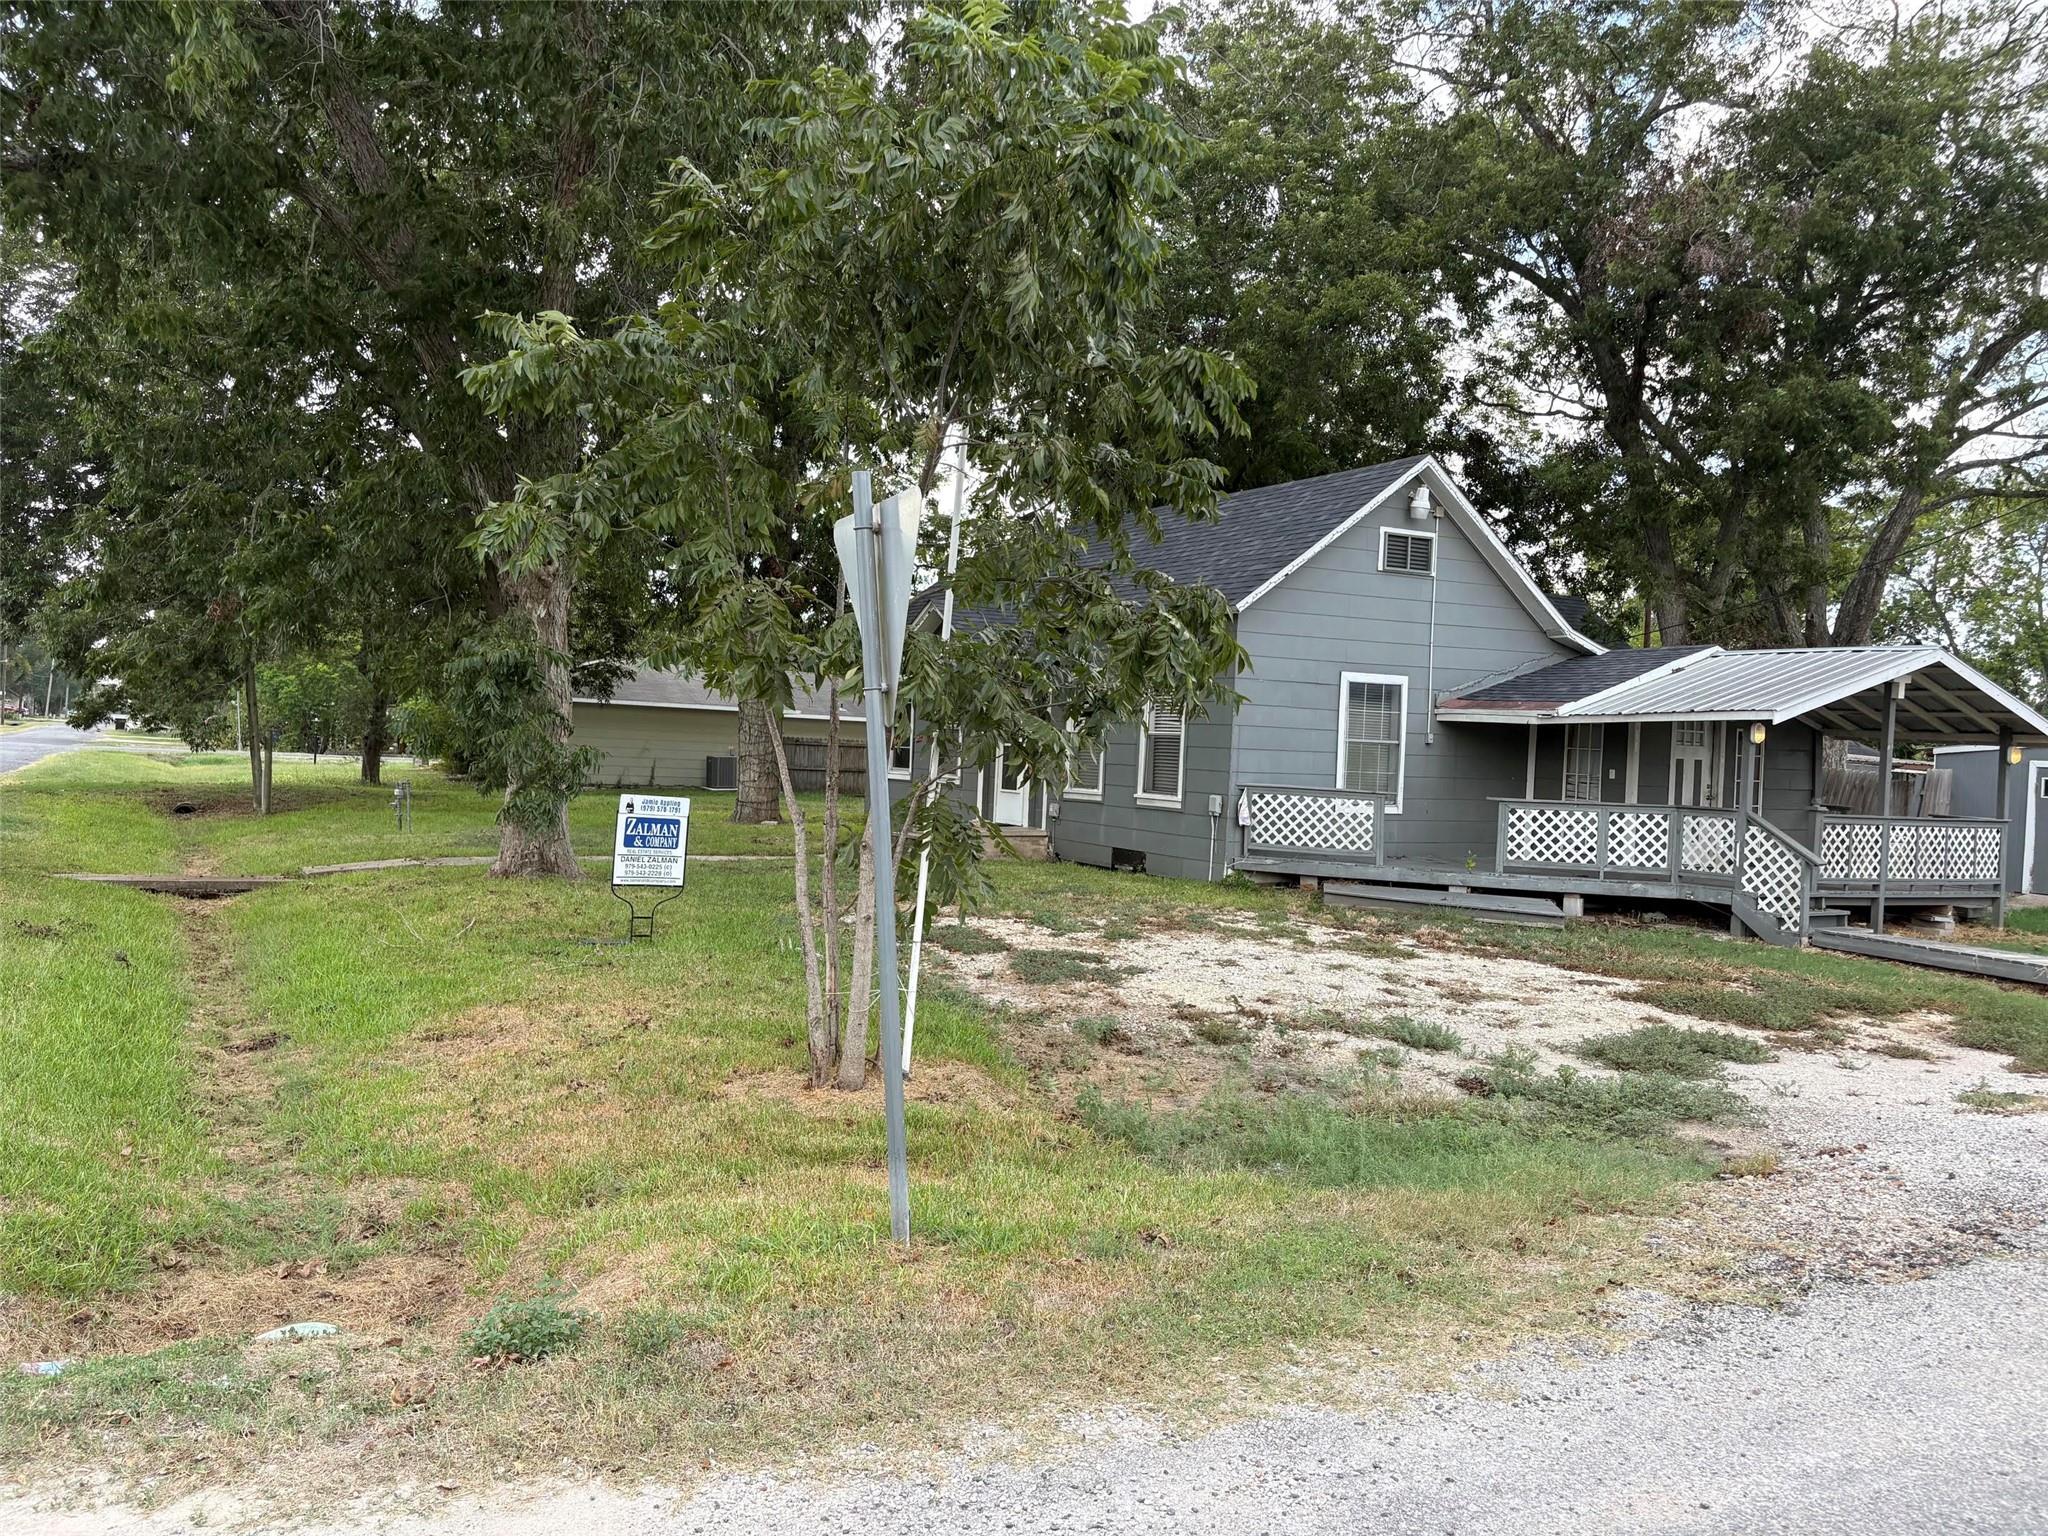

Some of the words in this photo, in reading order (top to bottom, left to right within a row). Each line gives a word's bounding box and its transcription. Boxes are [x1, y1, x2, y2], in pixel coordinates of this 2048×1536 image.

[626, 818, 679, 837] ZALMAN
[633, 836, 643, 846] &
[645, 836, 677, 848] COMPANY
[647, 856, 678, 864] ZALMAN
